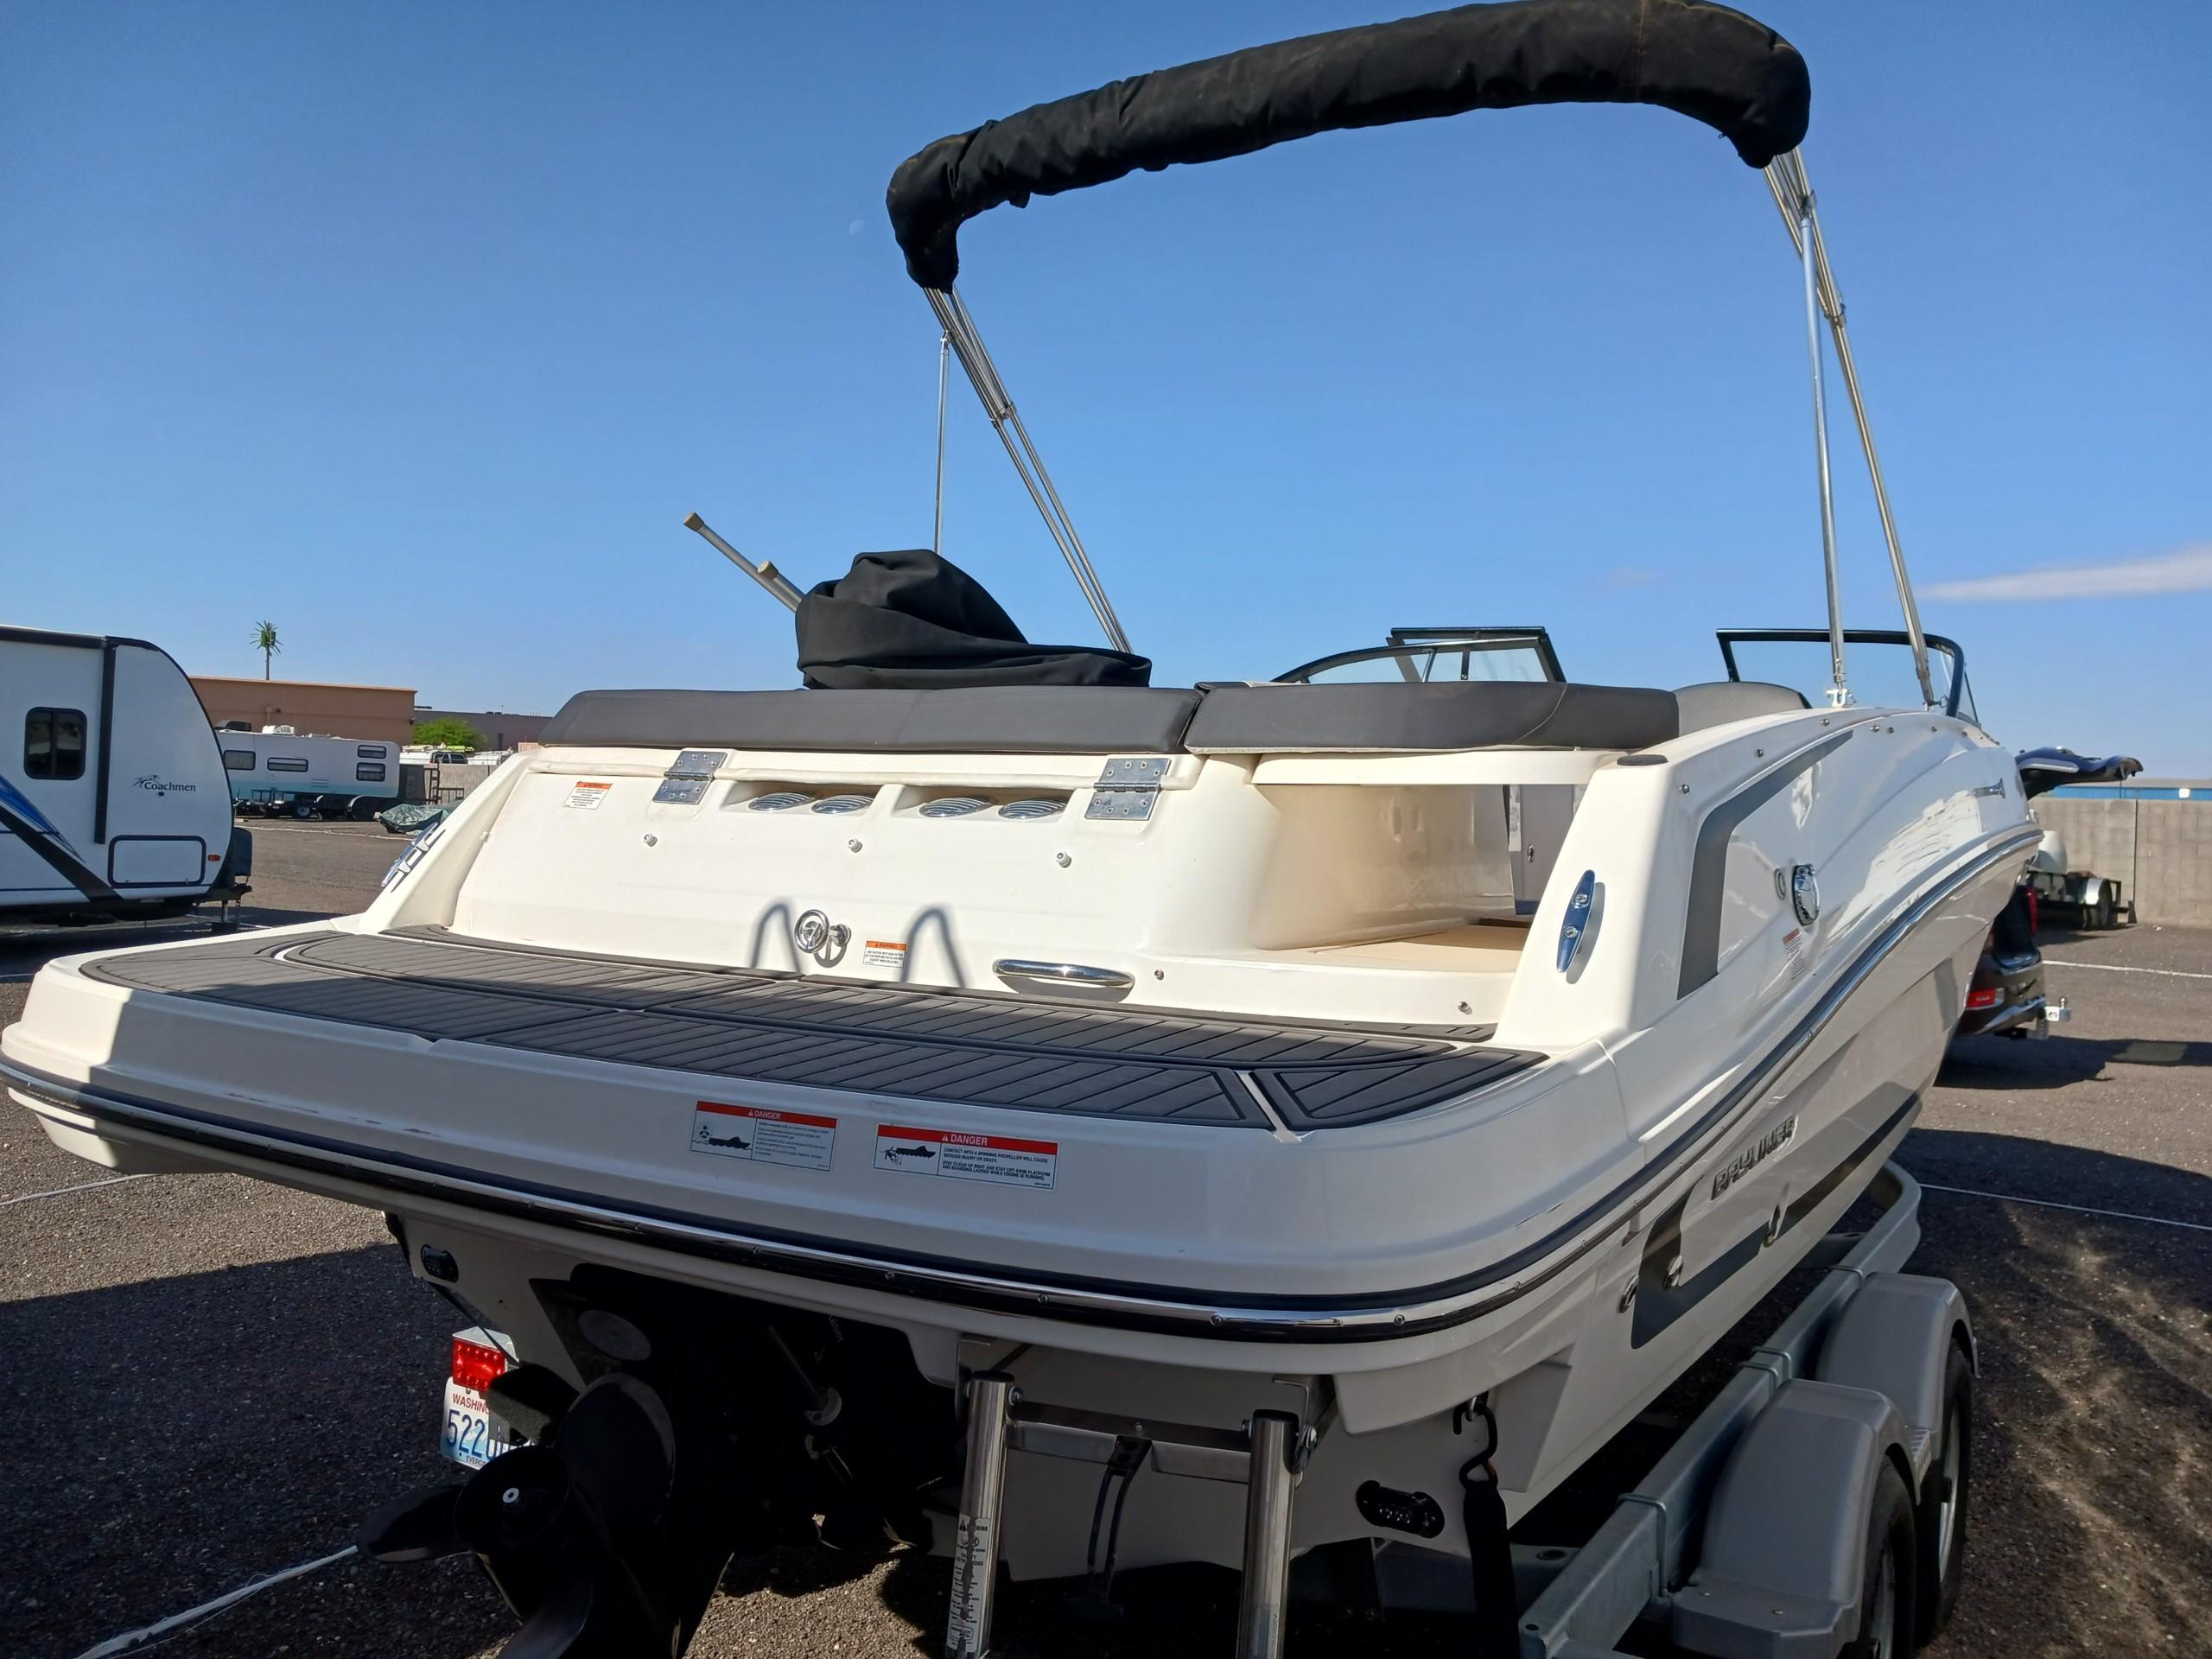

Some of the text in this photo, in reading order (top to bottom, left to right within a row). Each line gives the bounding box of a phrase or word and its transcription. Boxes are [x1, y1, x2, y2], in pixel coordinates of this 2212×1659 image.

[144, 781, 196, 791] Coachmen
[754, 1110, 781, 1120] DANGER
[950, 1134, 988, 1147] DANGER
